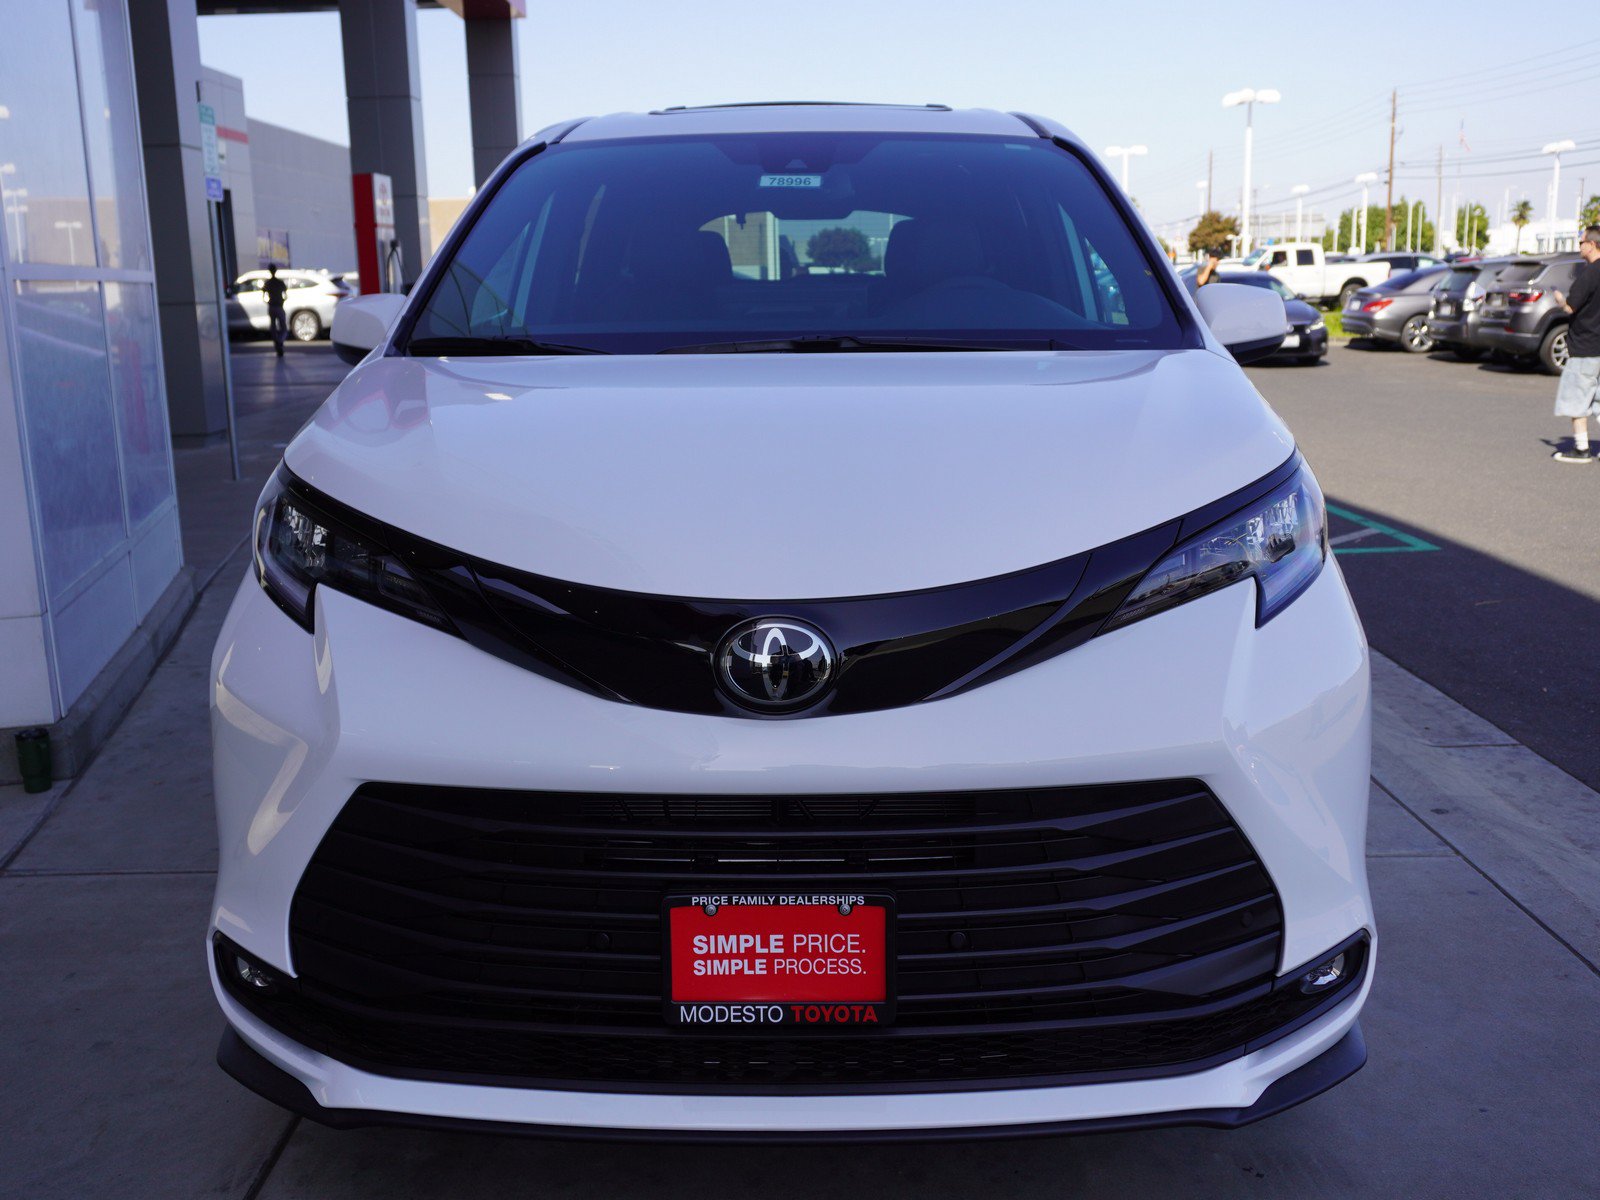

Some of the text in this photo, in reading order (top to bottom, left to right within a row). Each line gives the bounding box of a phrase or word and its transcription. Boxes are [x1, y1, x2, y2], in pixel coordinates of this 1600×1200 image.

[769, 177, 811, 186] 78996
[691, 896, 865, 906] PRICE FAMILY DEALERSHIPS
[692, 934, 866, 955] SIMPLE PRICE.
[693, 959, 867, 975] SIMPLE PROCESS.
[680, 1005, 878, 1023] MODESTO TOYOTA
